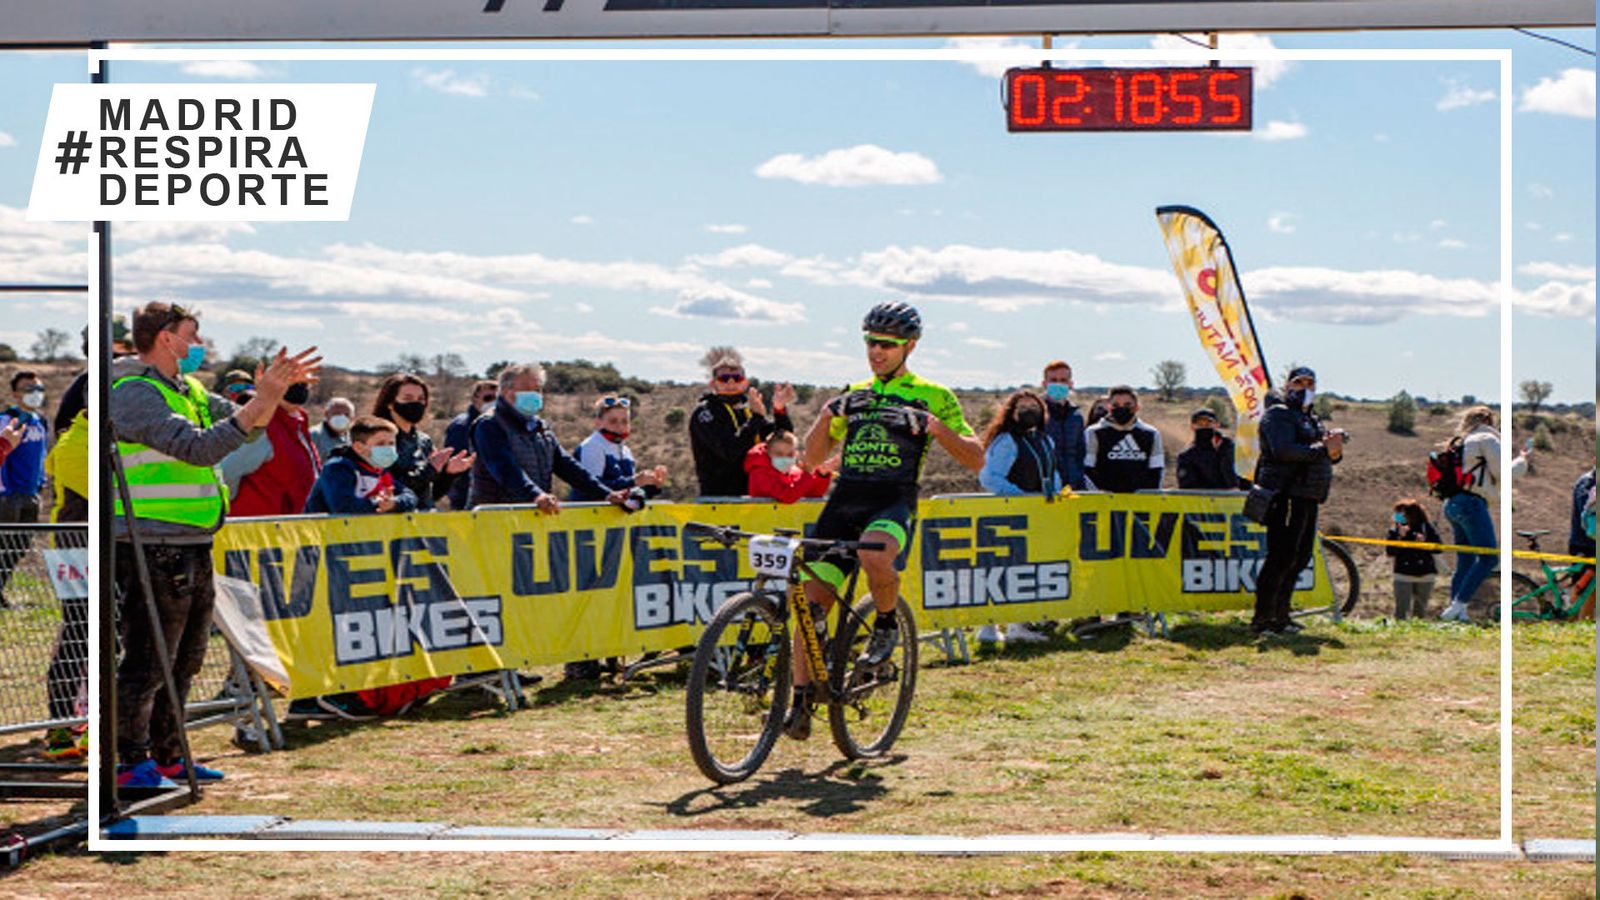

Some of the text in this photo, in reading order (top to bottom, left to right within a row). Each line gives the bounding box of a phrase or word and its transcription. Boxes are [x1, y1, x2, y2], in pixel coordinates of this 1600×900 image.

[1013, 73, 1241, 125] 02:18:55
[846, 441, 900, 455] MONTE
[1107, 448, 1148, 460] adidas
[512, 525, 738, 596] UVES
[752, 552, 788, 570] 359
[924, 563, 1070, 607] BIKES
[333, 598, 501, 664] BIKES
